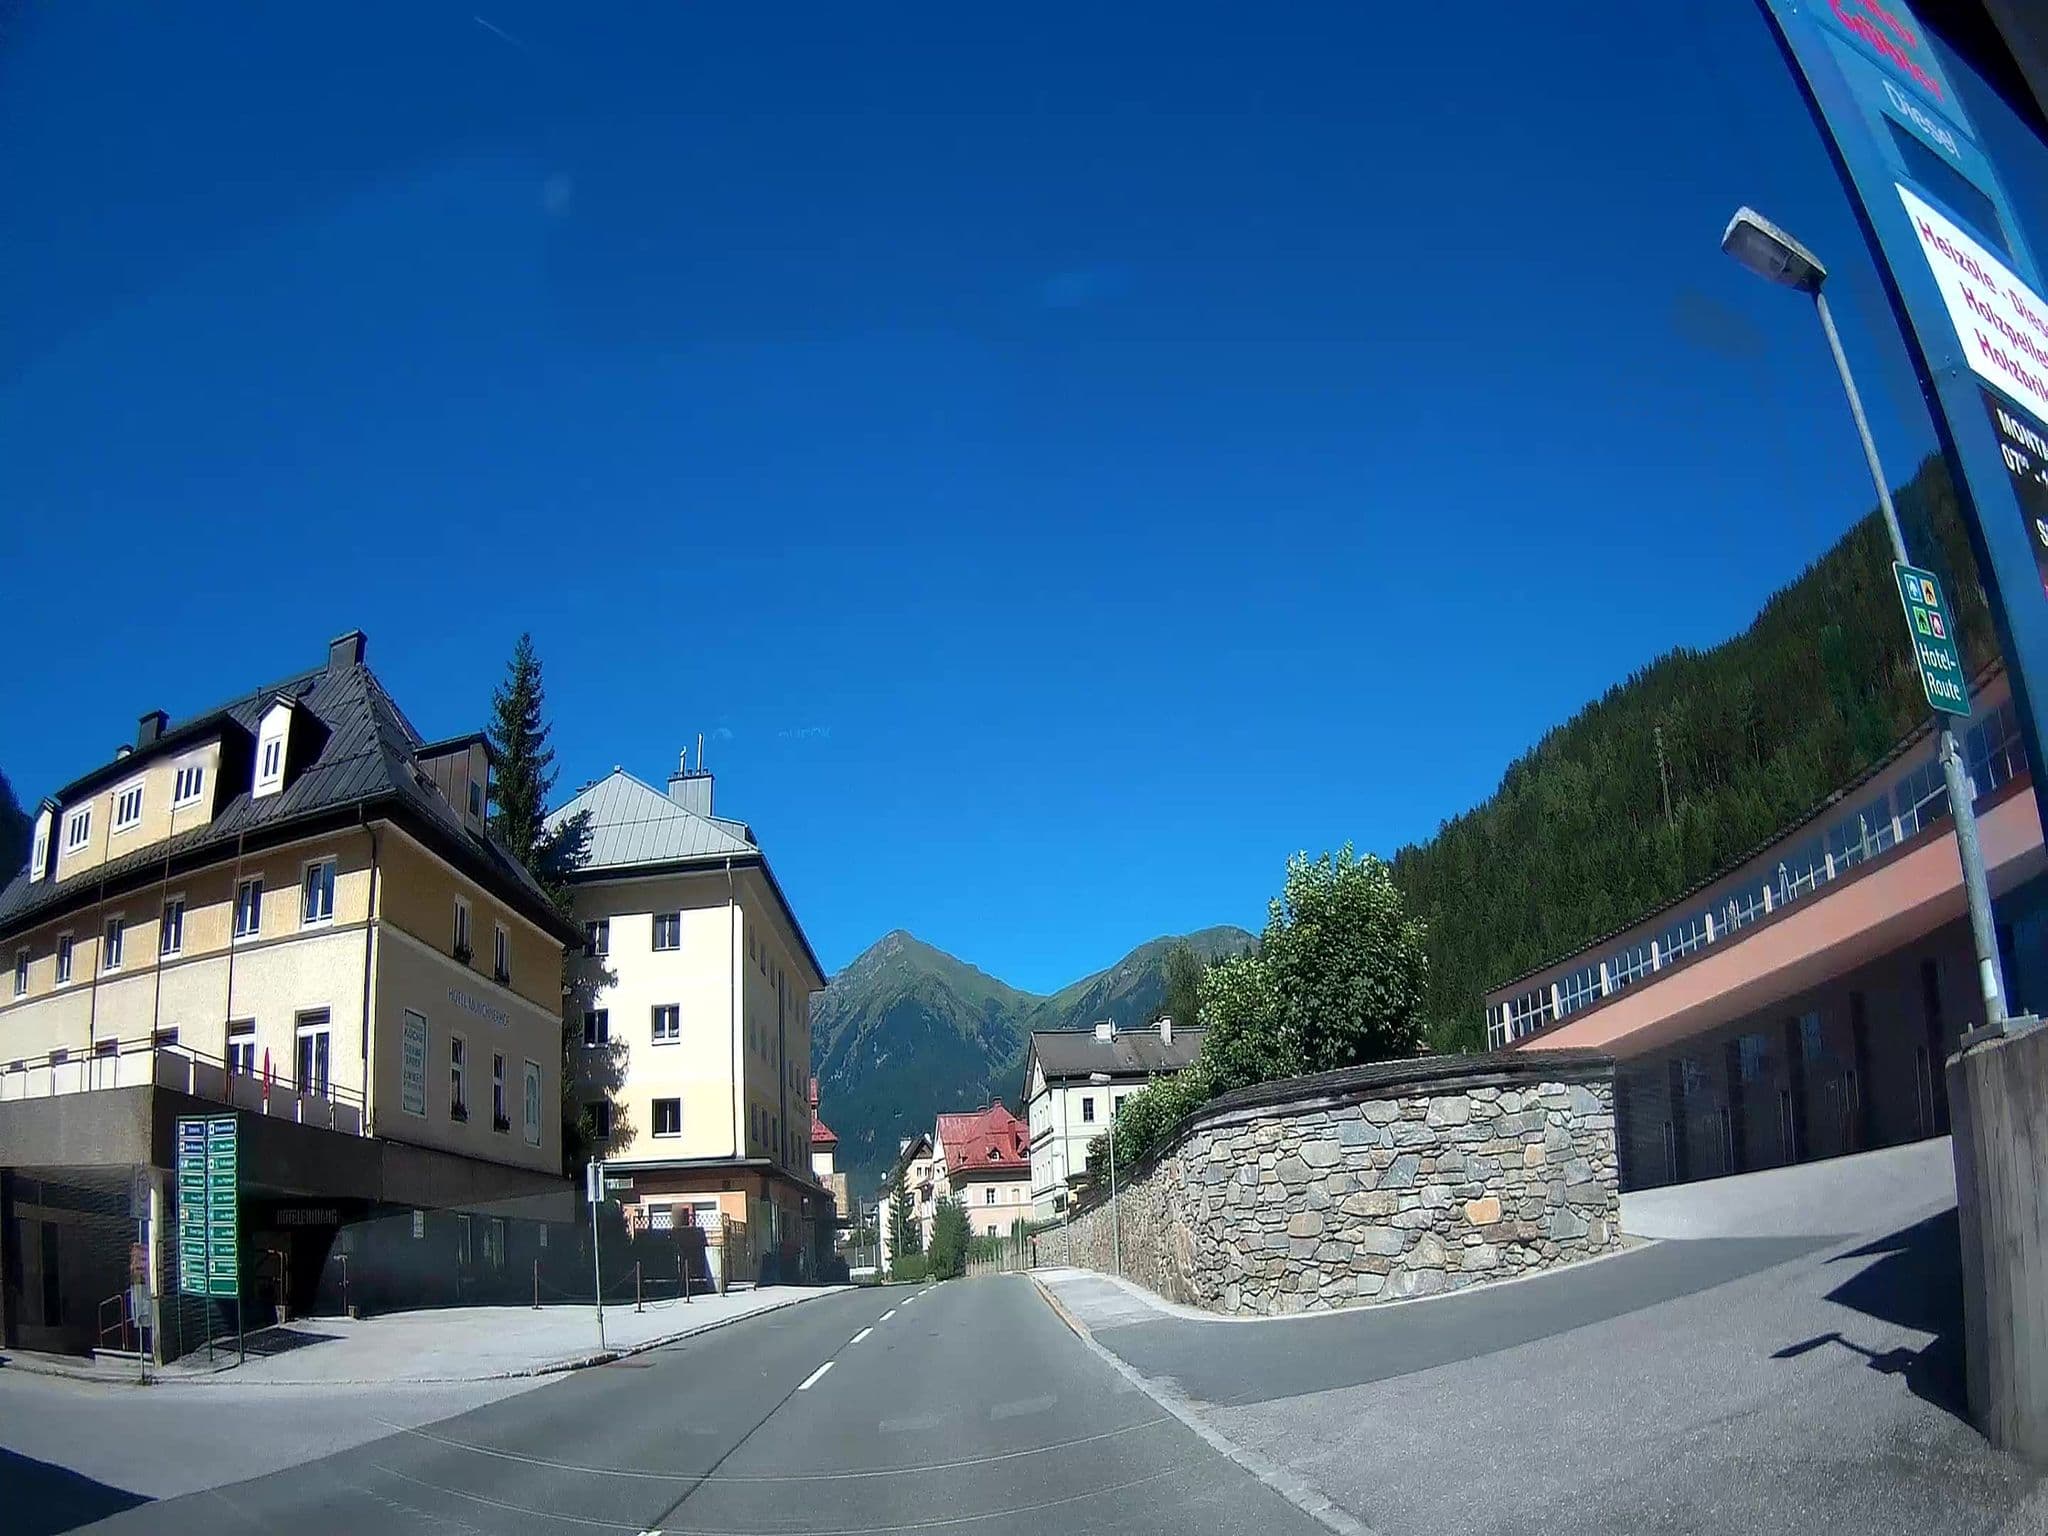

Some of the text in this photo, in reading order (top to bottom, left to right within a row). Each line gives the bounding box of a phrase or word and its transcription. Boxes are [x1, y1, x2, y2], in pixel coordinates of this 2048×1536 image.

[1881, 79, 1960, 160] Diesel
[1916, 215, 1997, 295] Heizöle
[1918, 641, 1957, 671] Hotel-
[1926, 671, 1962, 701] Route
